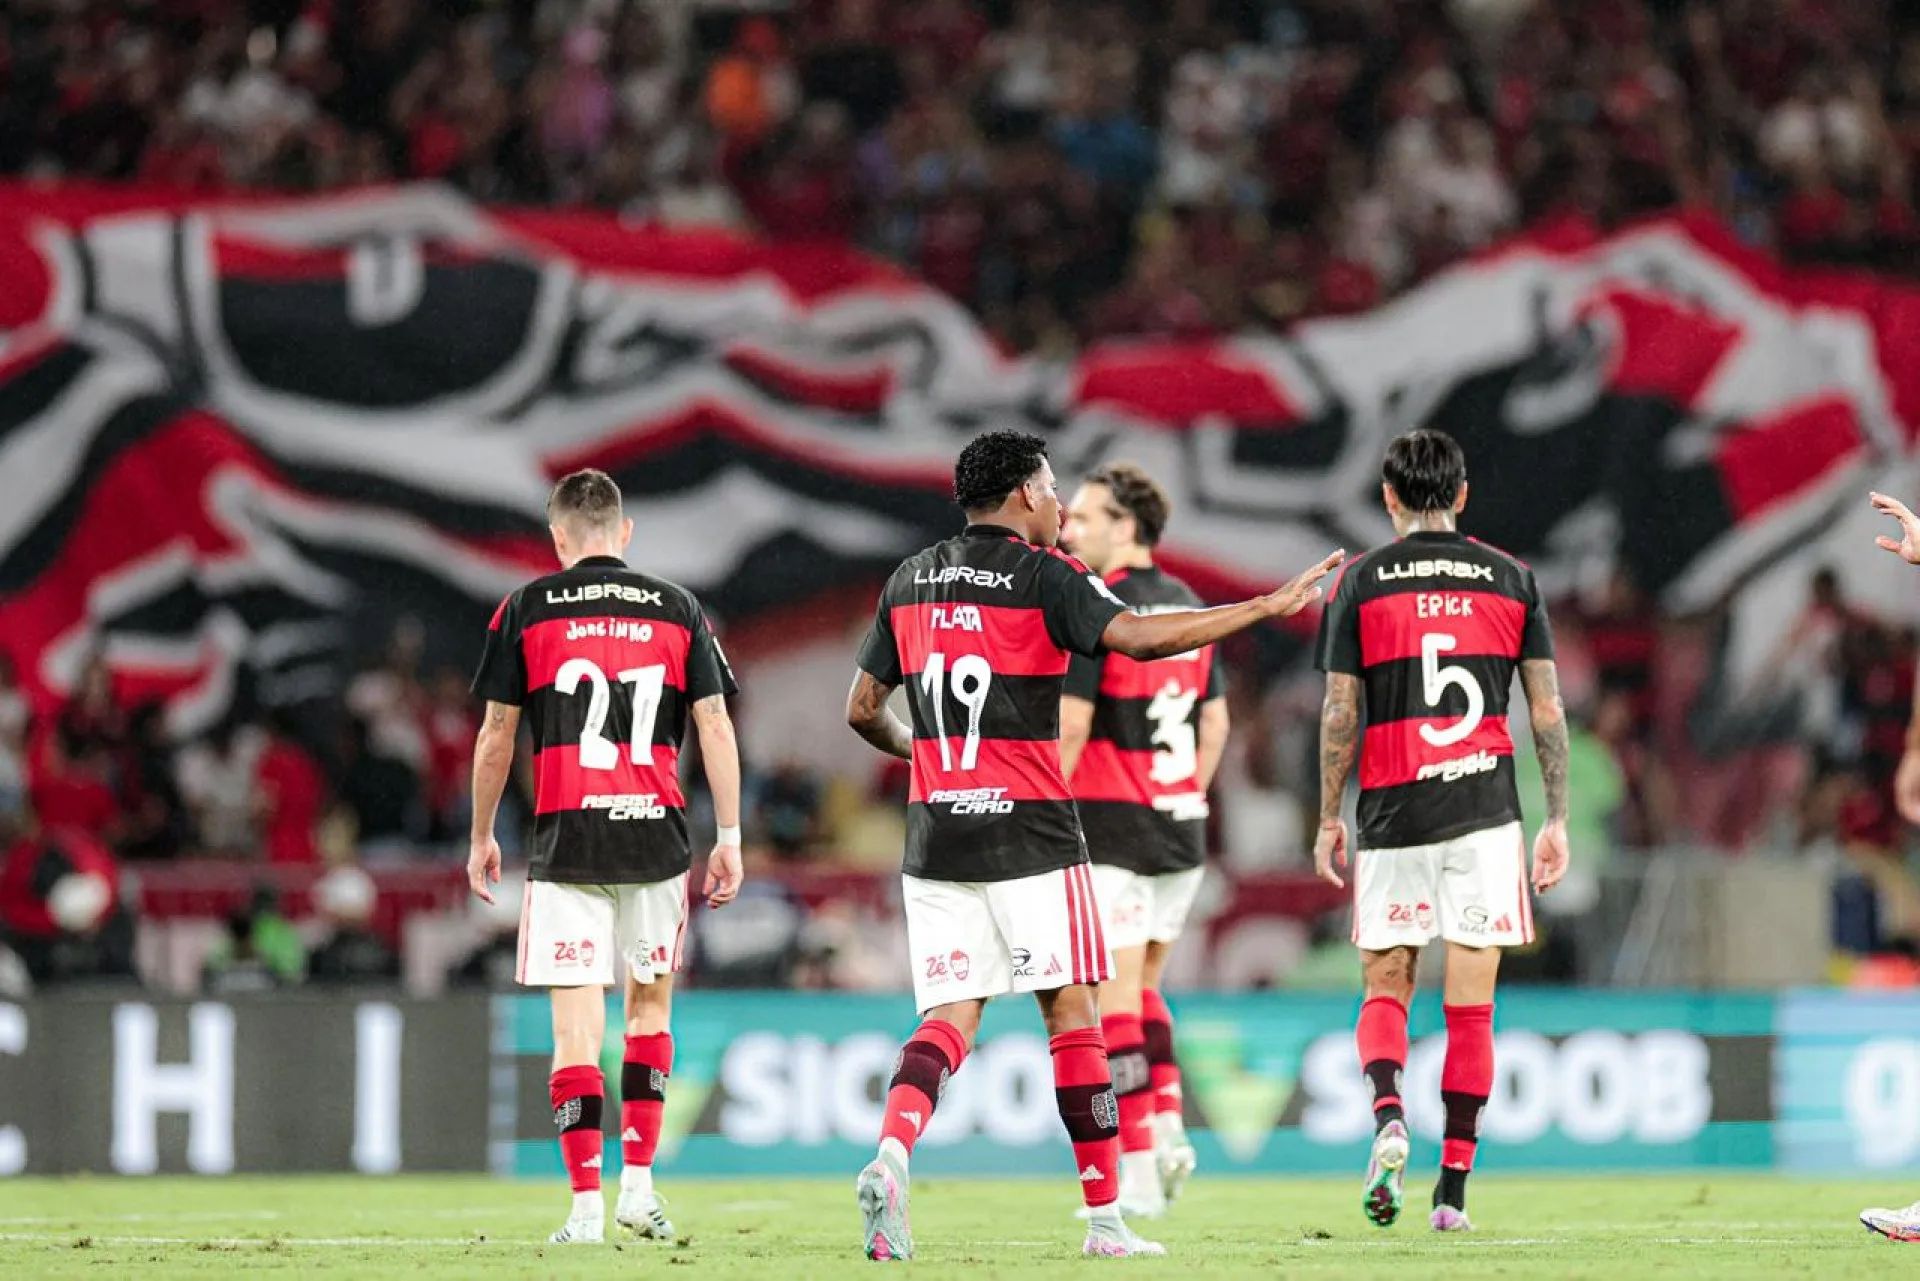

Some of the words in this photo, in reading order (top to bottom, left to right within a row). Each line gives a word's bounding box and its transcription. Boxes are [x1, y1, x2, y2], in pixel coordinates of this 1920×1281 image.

[930, 605, 983, 632] PLATA
[554, 658, 667, 771] 21
[922, 652, 991, 771] 19
[1419, 632, 1485, 746] 5
[1013, 967, 1035, 977] AC
[1301, 1028, 1713, 1145] SCOOB
